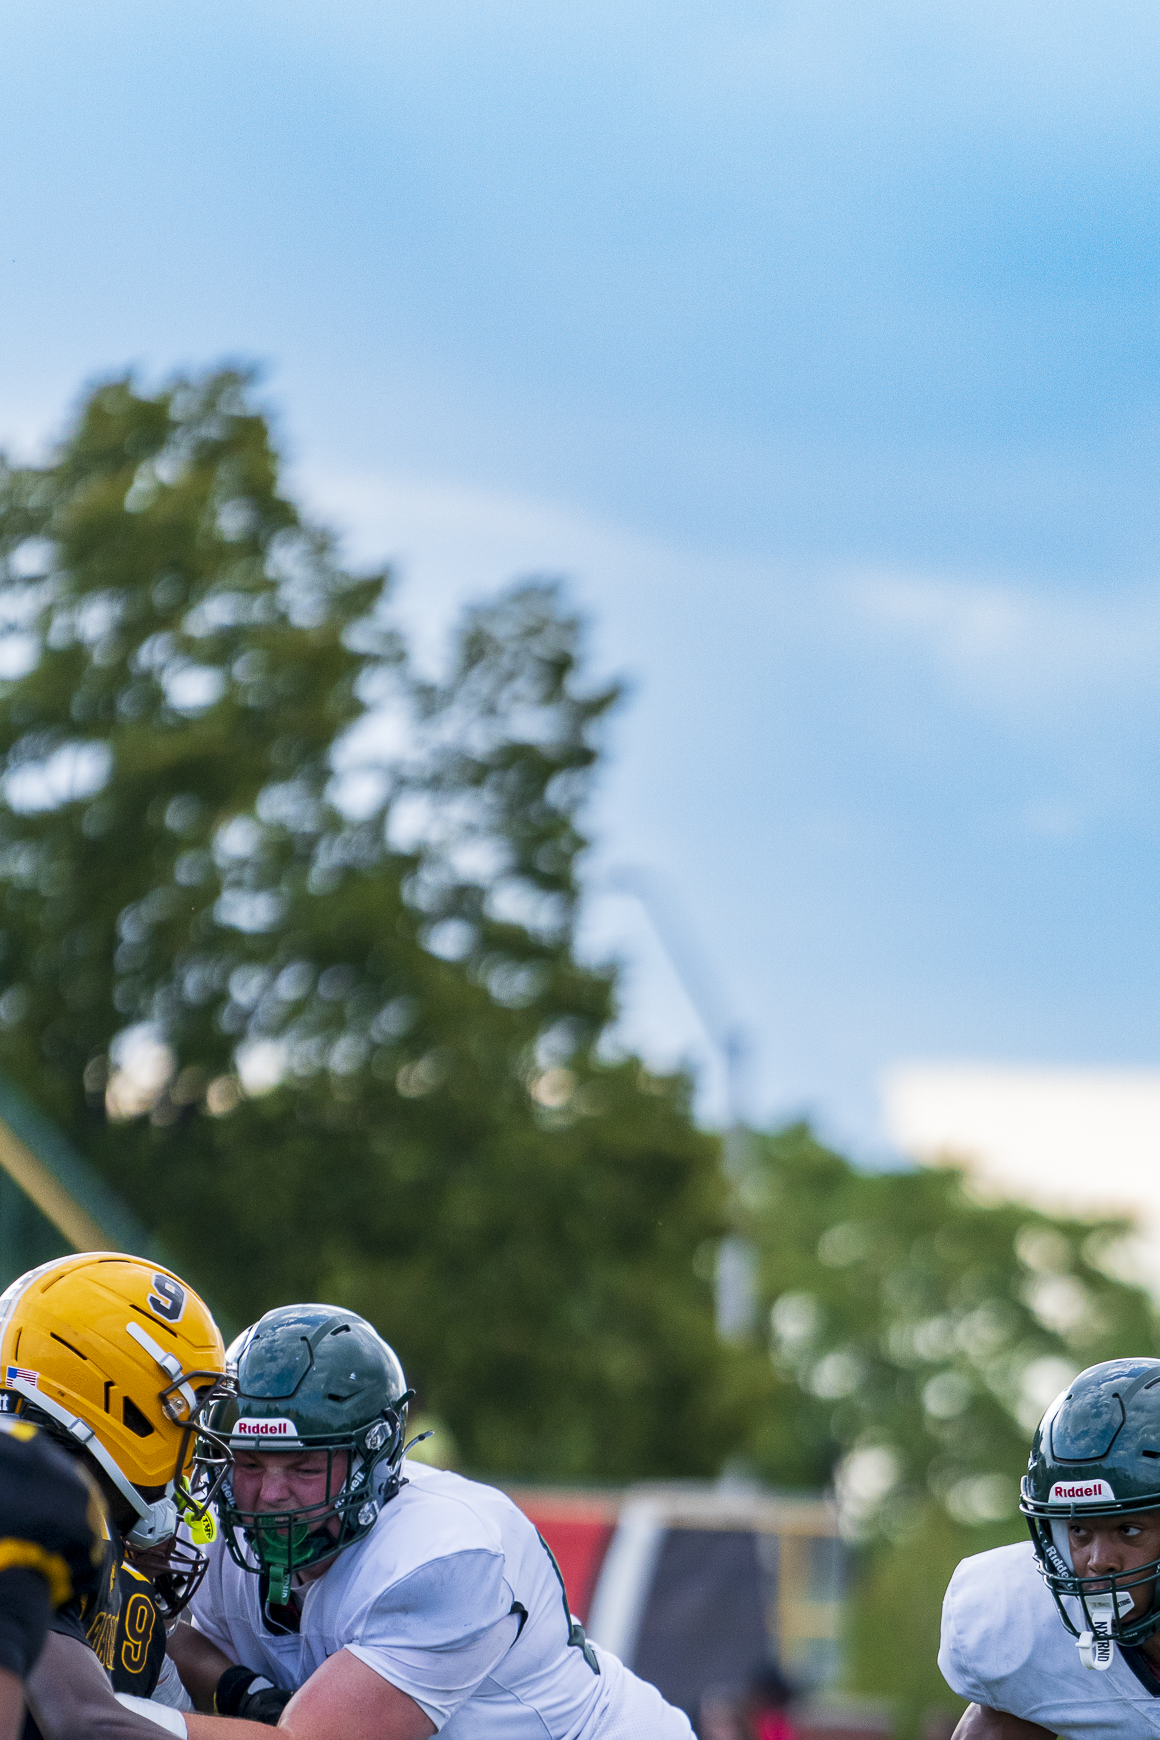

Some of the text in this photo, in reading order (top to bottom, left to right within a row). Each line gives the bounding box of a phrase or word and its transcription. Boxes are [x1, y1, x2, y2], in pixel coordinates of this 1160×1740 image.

[147, 1273, 187, 1323] 9
[238, 1422, 287, 1435] Riddell
[1054, 1483, 1102, 1498] Riddell
[1046, 1545, 1075, 1590] Ridde
[121, 1592, 156, 1674] 9
[1094, 1621, 1110, 1662] NXRND
